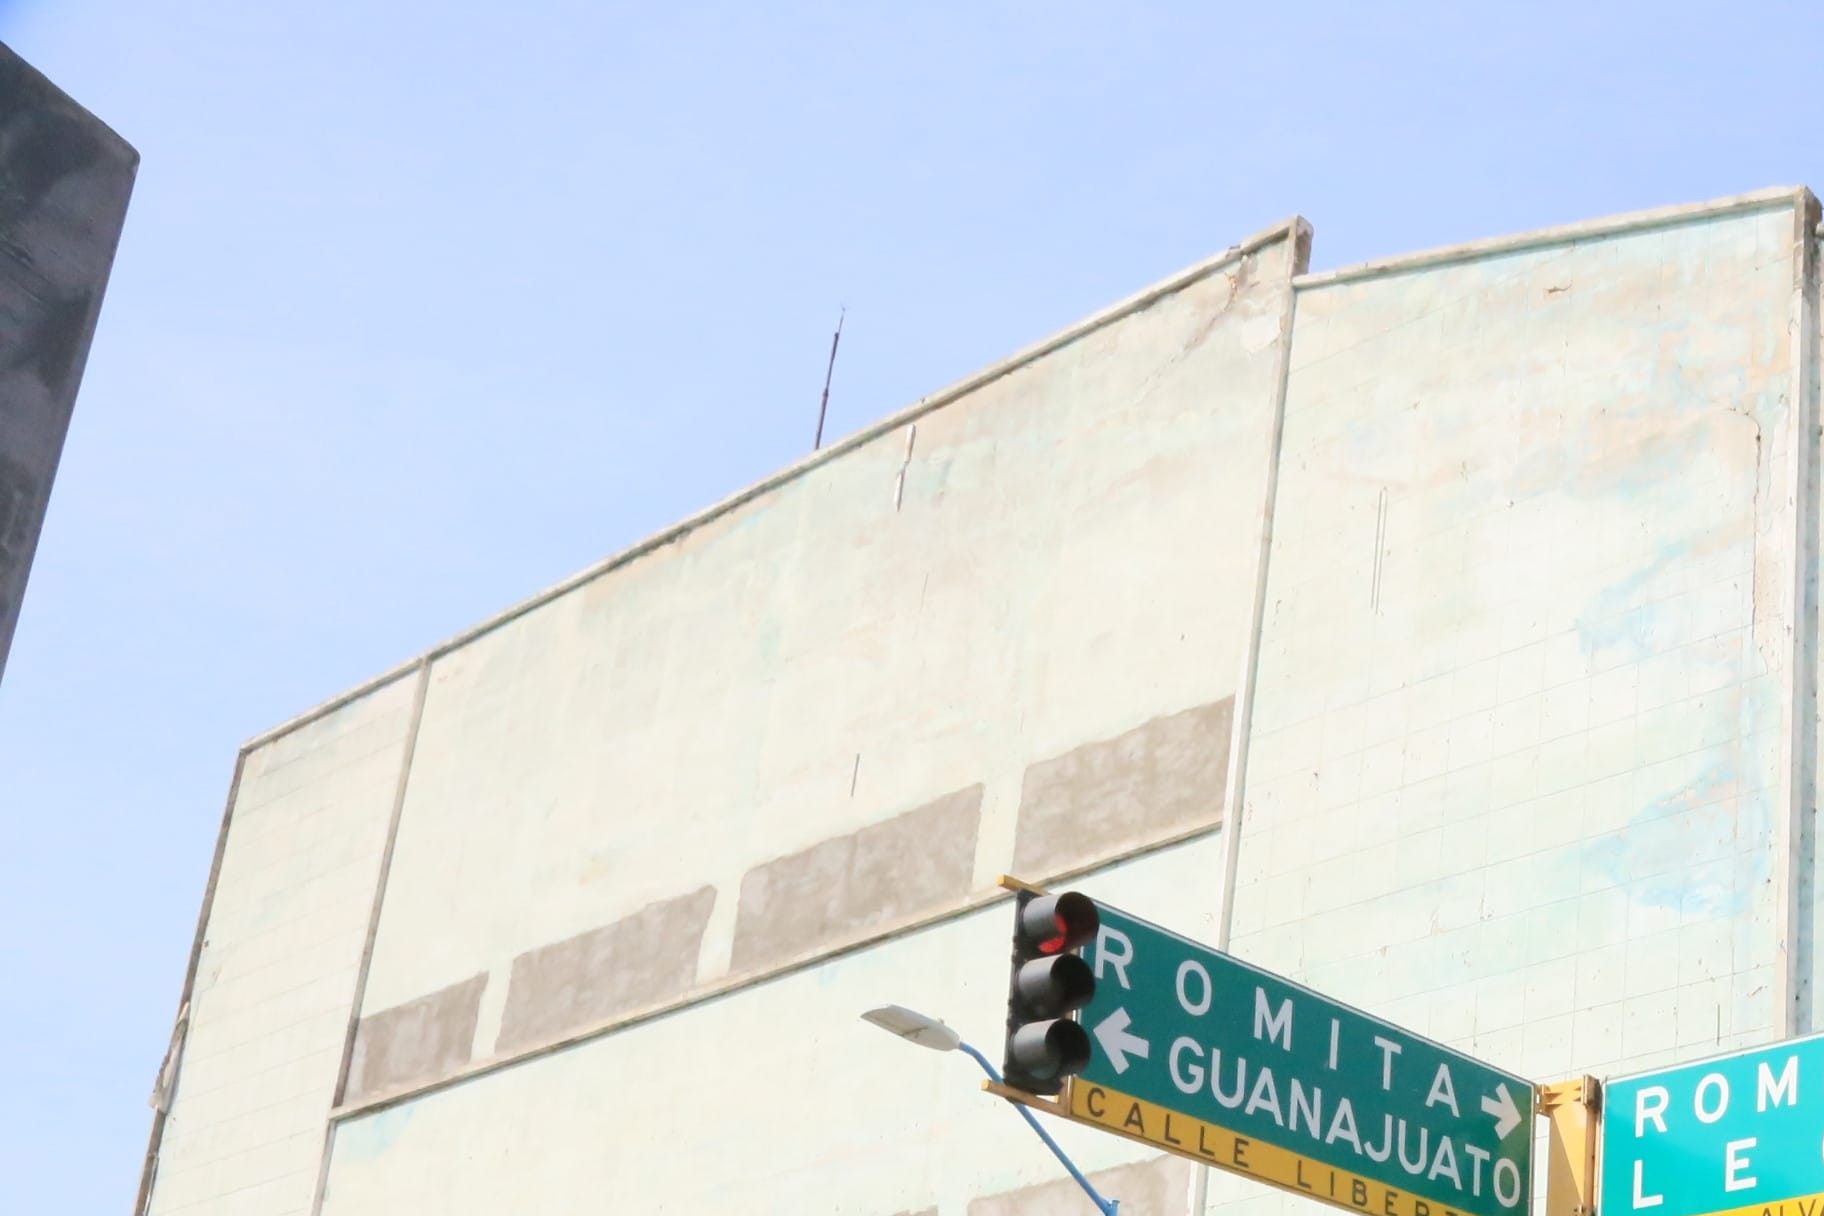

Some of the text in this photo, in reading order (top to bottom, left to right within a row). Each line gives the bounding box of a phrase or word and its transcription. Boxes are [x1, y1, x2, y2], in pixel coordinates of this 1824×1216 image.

[1097, 923, 1461, 1119] ROMITA
[1087, 1086, 1251, 1169] CALLE
[1168, 1036, 1521, 1209] GUANAJUATO
